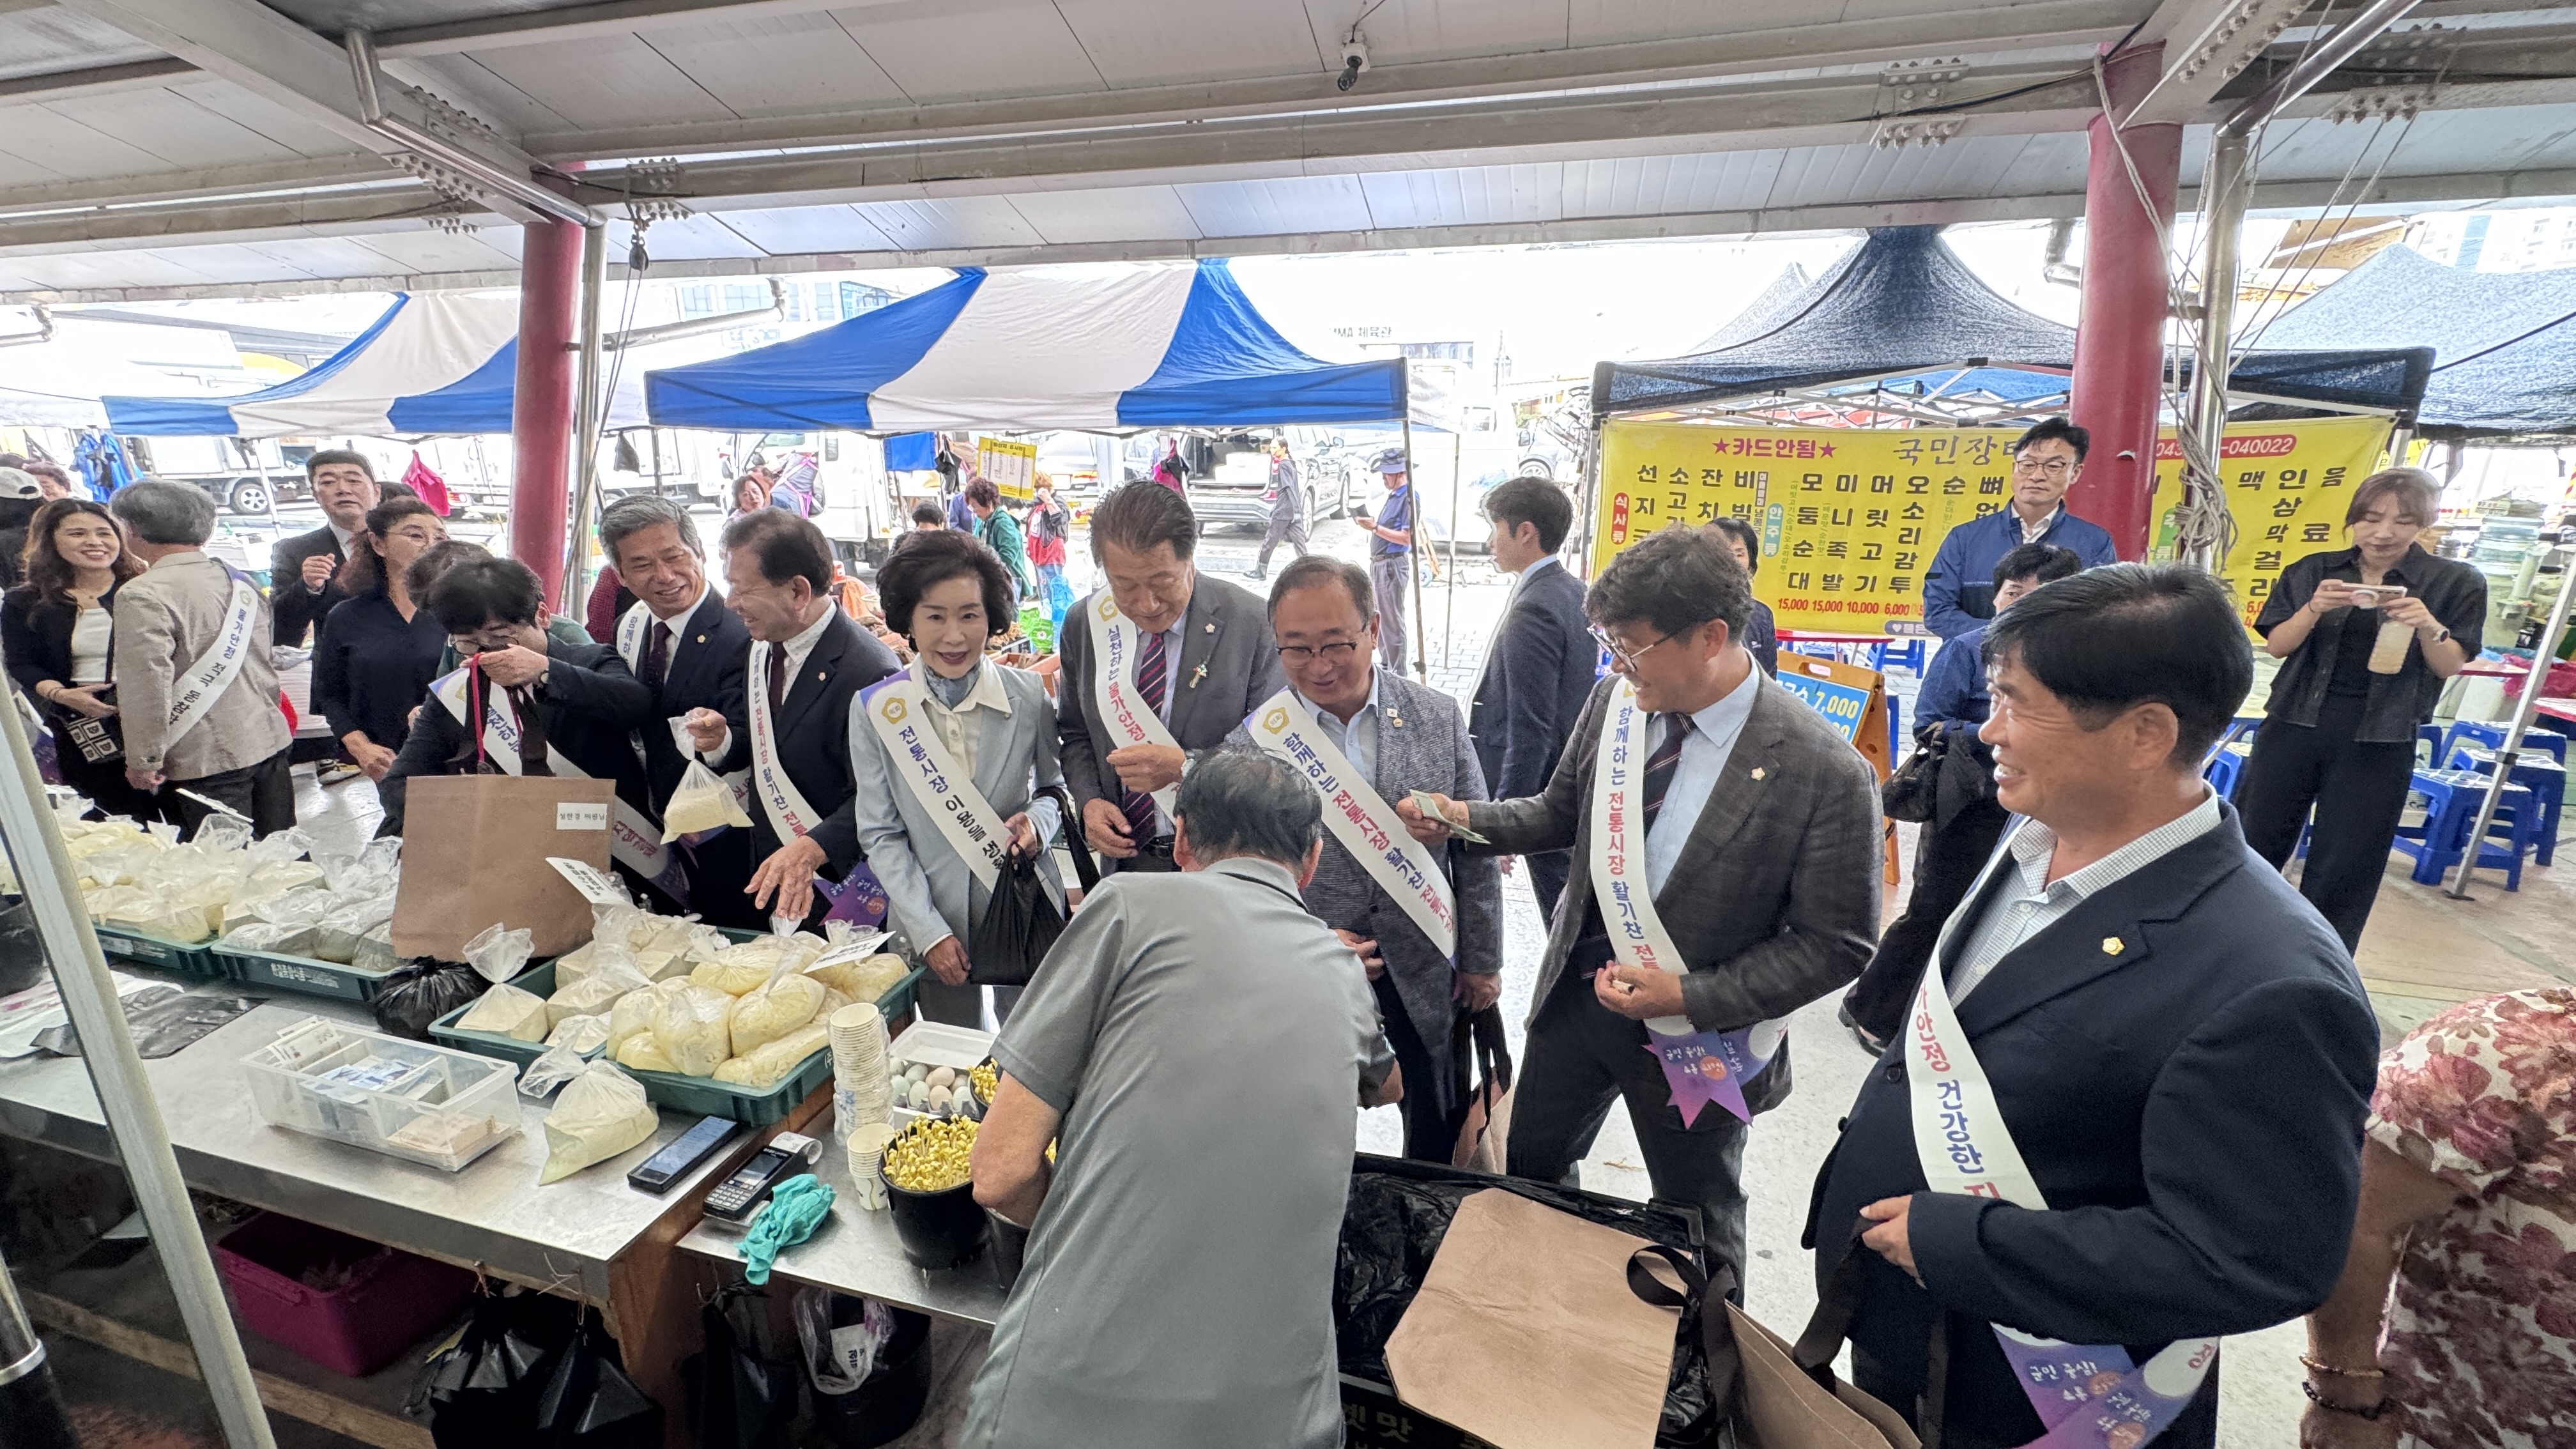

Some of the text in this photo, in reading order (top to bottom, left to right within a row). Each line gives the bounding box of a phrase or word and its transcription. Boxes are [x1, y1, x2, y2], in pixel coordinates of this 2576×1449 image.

[1358, 326, 1393, 338] 체육관
[1732, 438, 1816, 459] 카드안됨
[1613, 495, 1629, 544] 식사류
[1764, 507, 1784, 556] 안주류
[1788, 473, 1823, 591] 모둠순대
[1821, 474, 1859, 592] 미니족발
[1853, 475, 1894, 594] 머릿고기
[1887, 475, 1929, 594] 오소리감투
[1778, 598, 1809, 611] 15,000
[1812, 599, 1843, 613] 15,000
[1846, 601, 1879, 615] 10,000
[1884, 603, 1910, 617] 6,000
[1107, 624, 1146, 742] 실천하는 물가안정
[1813, 691, 1860, 719] 7,000
[755, 705, 769, 765] 전통시장
[762, 767, 790, 811] 활기찬
[898, 725, 949, 794] 전통시장
[945, 794, 987, 843] 이용을
[1610, 705, 1633, 786] 함께하는
[1282, 732, 1340, 794] 함께하는
[1331, 789, 1391, 852] 전통시장
[1384, 847, 1426, 890] 활기찬
[1606, 791, 1625, 876] 전통시장
[1611, 880, 1644, 941] 활기찬
[1915, 973, 1952, 1072] 가안정
[1936, 1078, 1985, 1174] 건강한
